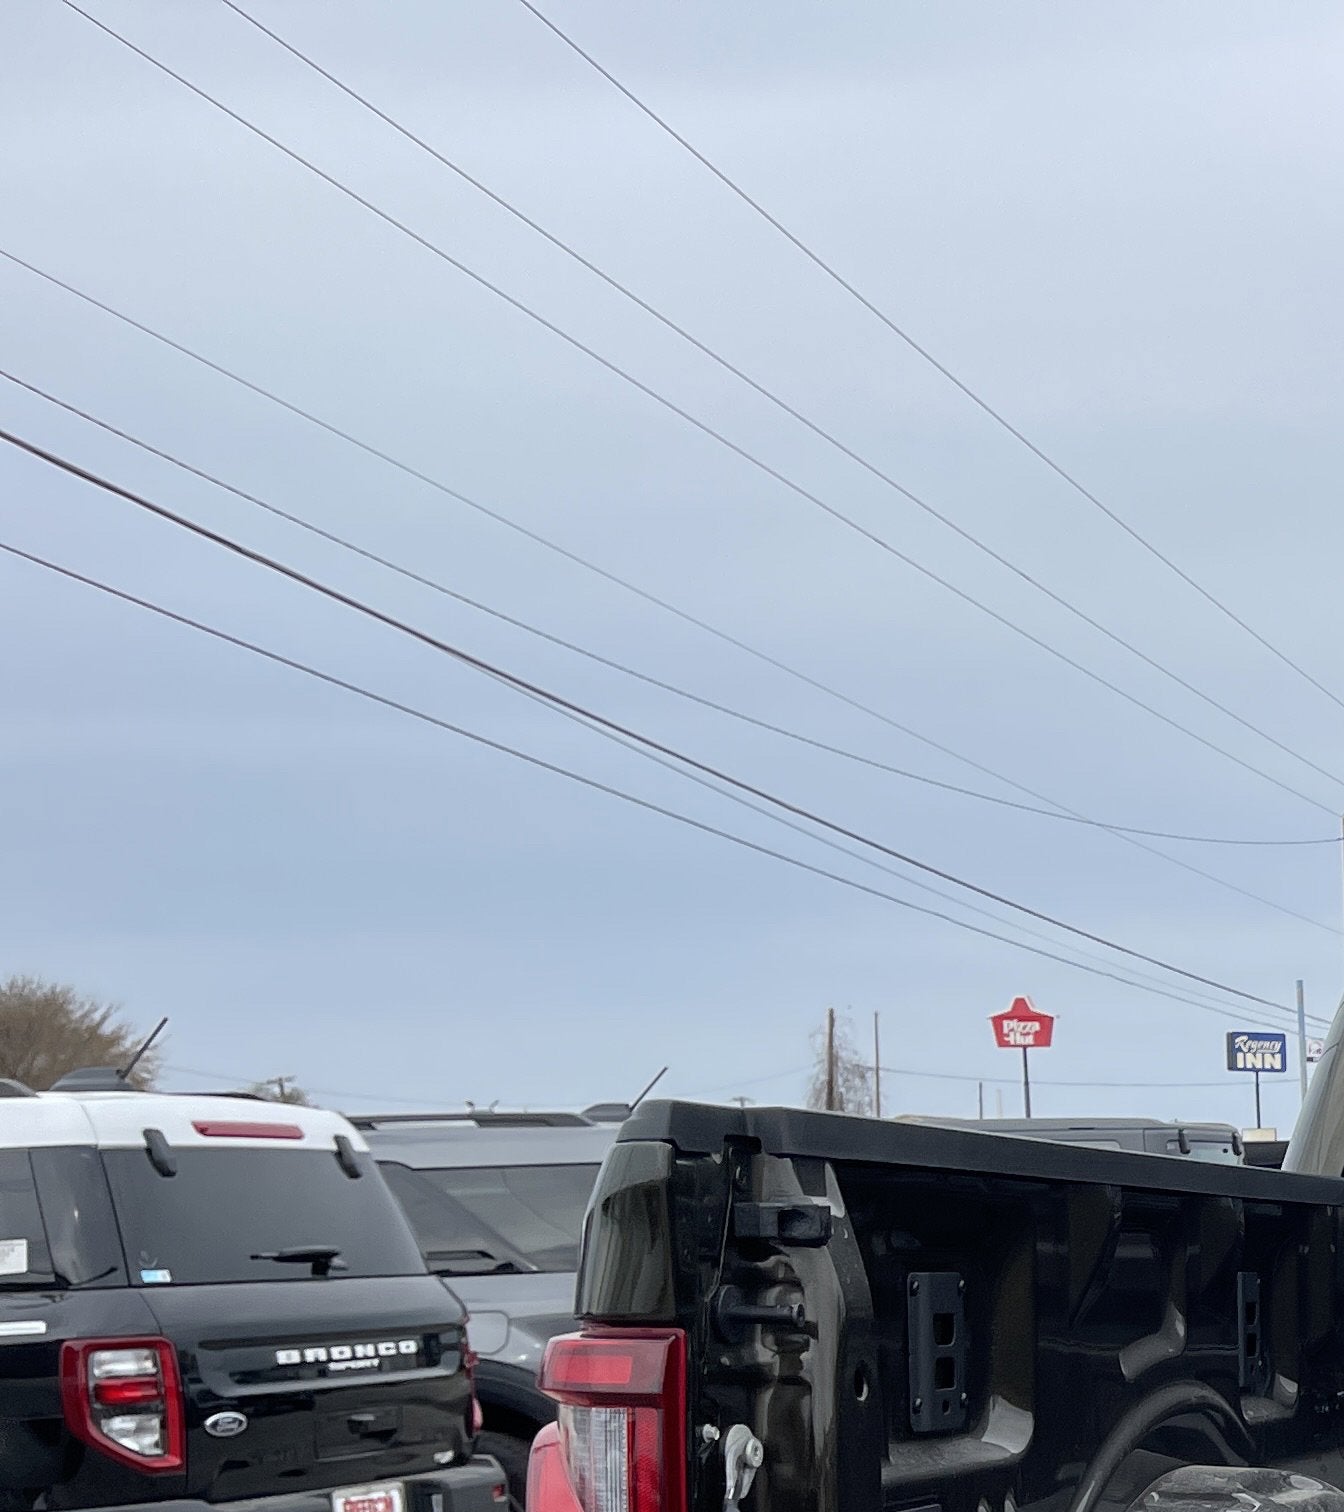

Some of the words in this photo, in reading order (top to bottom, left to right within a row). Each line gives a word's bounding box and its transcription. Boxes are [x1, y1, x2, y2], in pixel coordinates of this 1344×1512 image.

[1003, 1019, 1041, 1034] Pizza
[1004, 1031, 1035, 1046] Hut
[1234, 1034, 1283, 1054] Regency
[1236, 1052, 1282, 1070] INN
[275, 1339, 418, 1366] BRONCO
